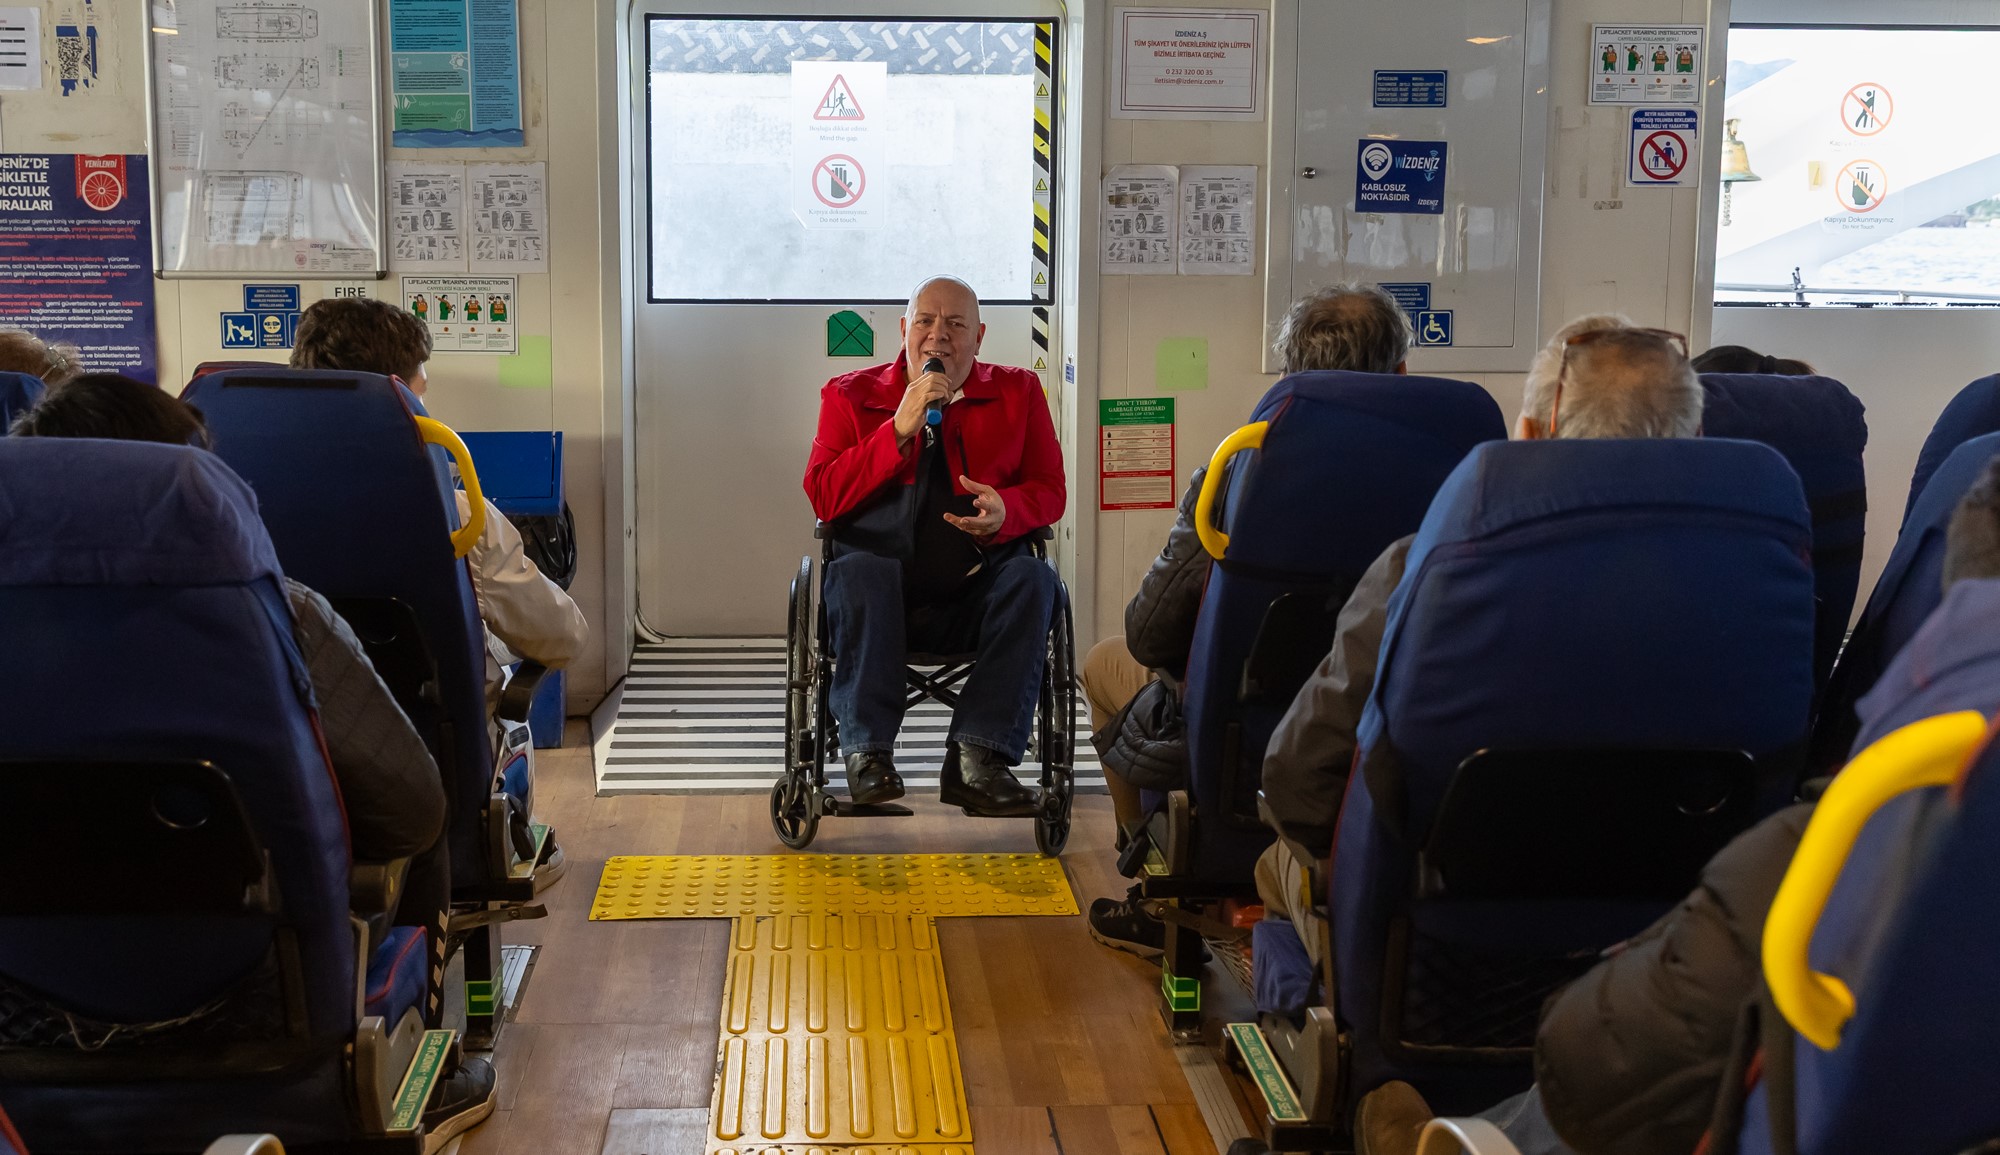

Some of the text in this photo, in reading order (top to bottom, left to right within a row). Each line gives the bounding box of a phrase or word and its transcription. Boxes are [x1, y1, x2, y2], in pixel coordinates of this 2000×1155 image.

[1175, 30, 1207, 39] İZDENİZ A.Ş
[1148, 40, 1169, 48] ŞİKAYET
[1179, 40, 1216, 48] ÖNERİLERİNİZ
[1217, 40, 1229, 49] İÇİN
[1231, 41, 1251, 49] LÜTFEN
[1178, 50, 1202, 58] İRTİBATA
[1203, 51, 1226, 59] GEÇİNİZ.
[1154, 77, 1224, 85] iletisim@izdeniz.com.tr
[0, 155, 50, 169] ENİZ'DE
[85, 159, 117, 168] YENİLENDİ
[1395, 154, 1440, 170] WİZDENİZ
[0, 185, 51, 197] LCULUK
[1361, 183, 1406, 192] KABLOSUZ
[1361, 193, 1410, 201] NOKTASIDIR
[0, 199, 53, 211] RALLARI
[1848, 216, 1894, 224] Dokunmayınız
[334, 287, 366, 297] FIRE
[419, 1046, 439, 1072] HANDICAP
[430, 1034, 445, 1045] SEAT
